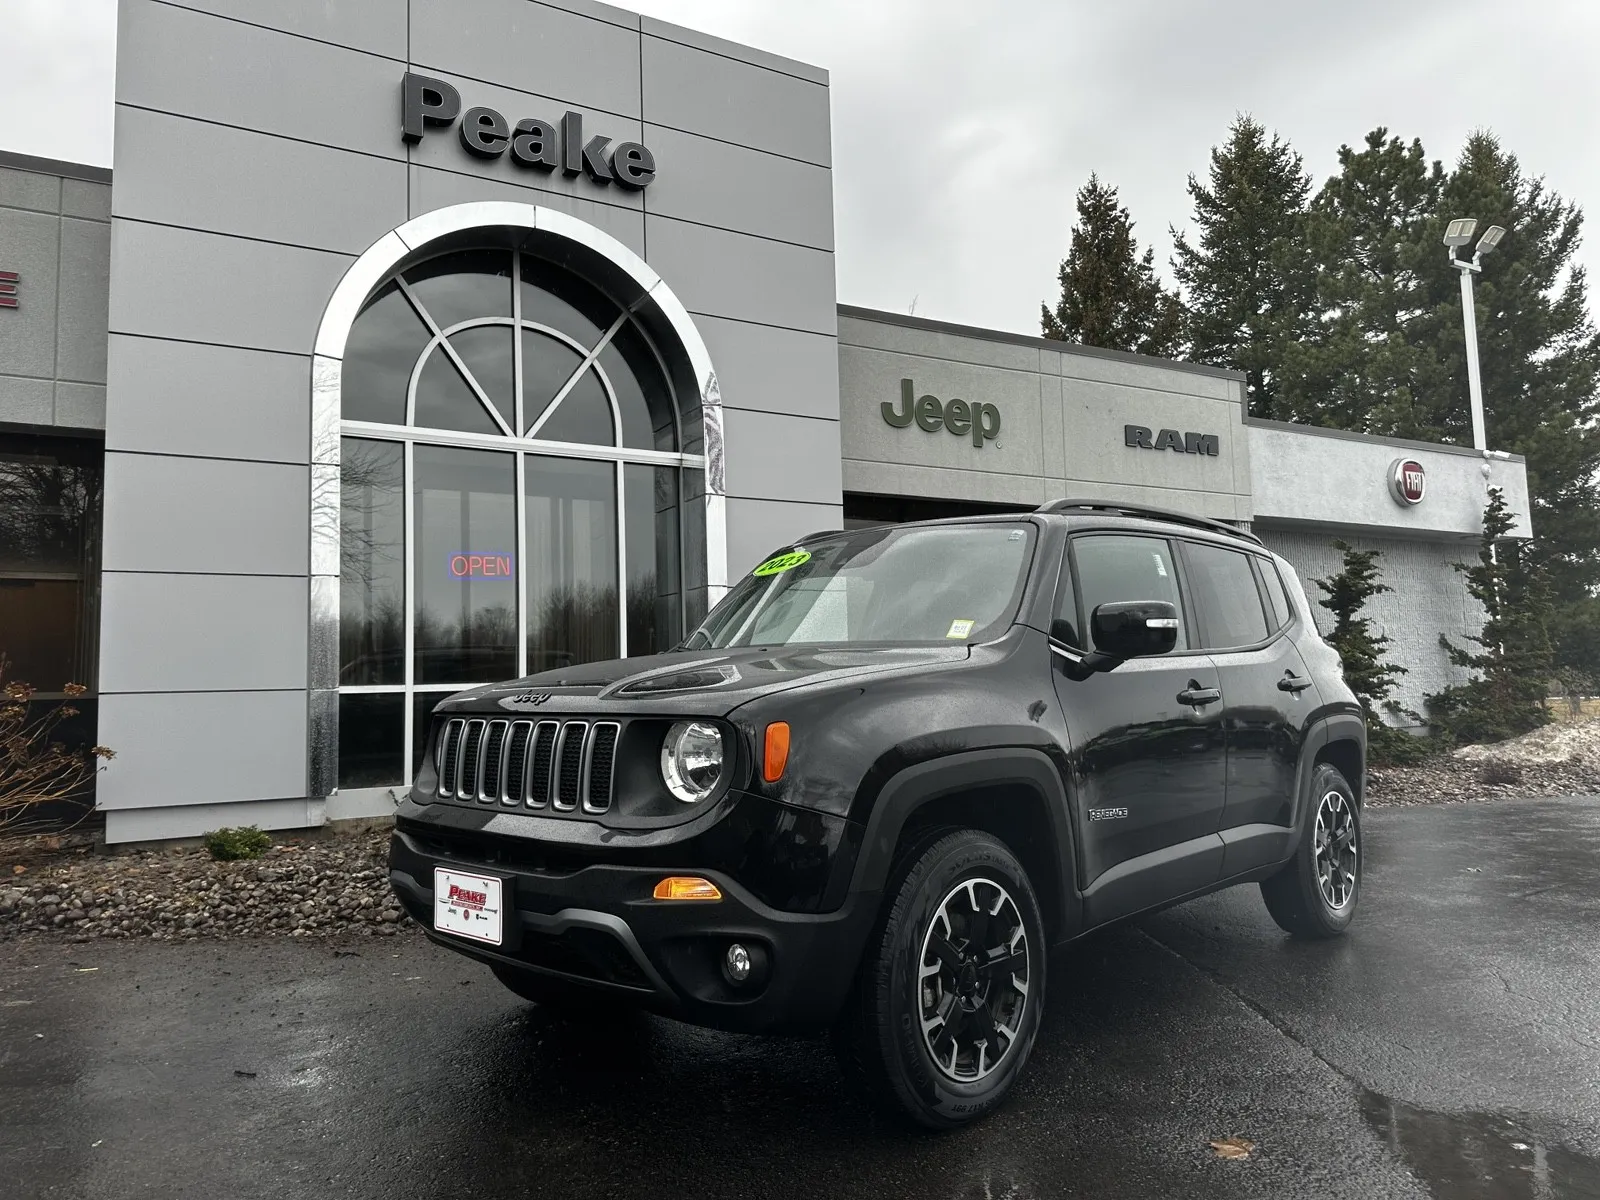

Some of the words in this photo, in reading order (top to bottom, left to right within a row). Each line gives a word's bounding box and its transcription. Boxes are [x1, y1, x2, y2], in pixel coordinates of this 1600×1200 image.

[401, 72, 656, 192] Peake
[881, 378, 1001, 447] Jeep
[1124, 424, 1219, 456] RAM
[1404, 470, 1424, 491] FIAT
[451, 556, 510, 576] OPEN
[757, 554, 807, 574] 2023
[513, 689, 552, 706] Jeep
